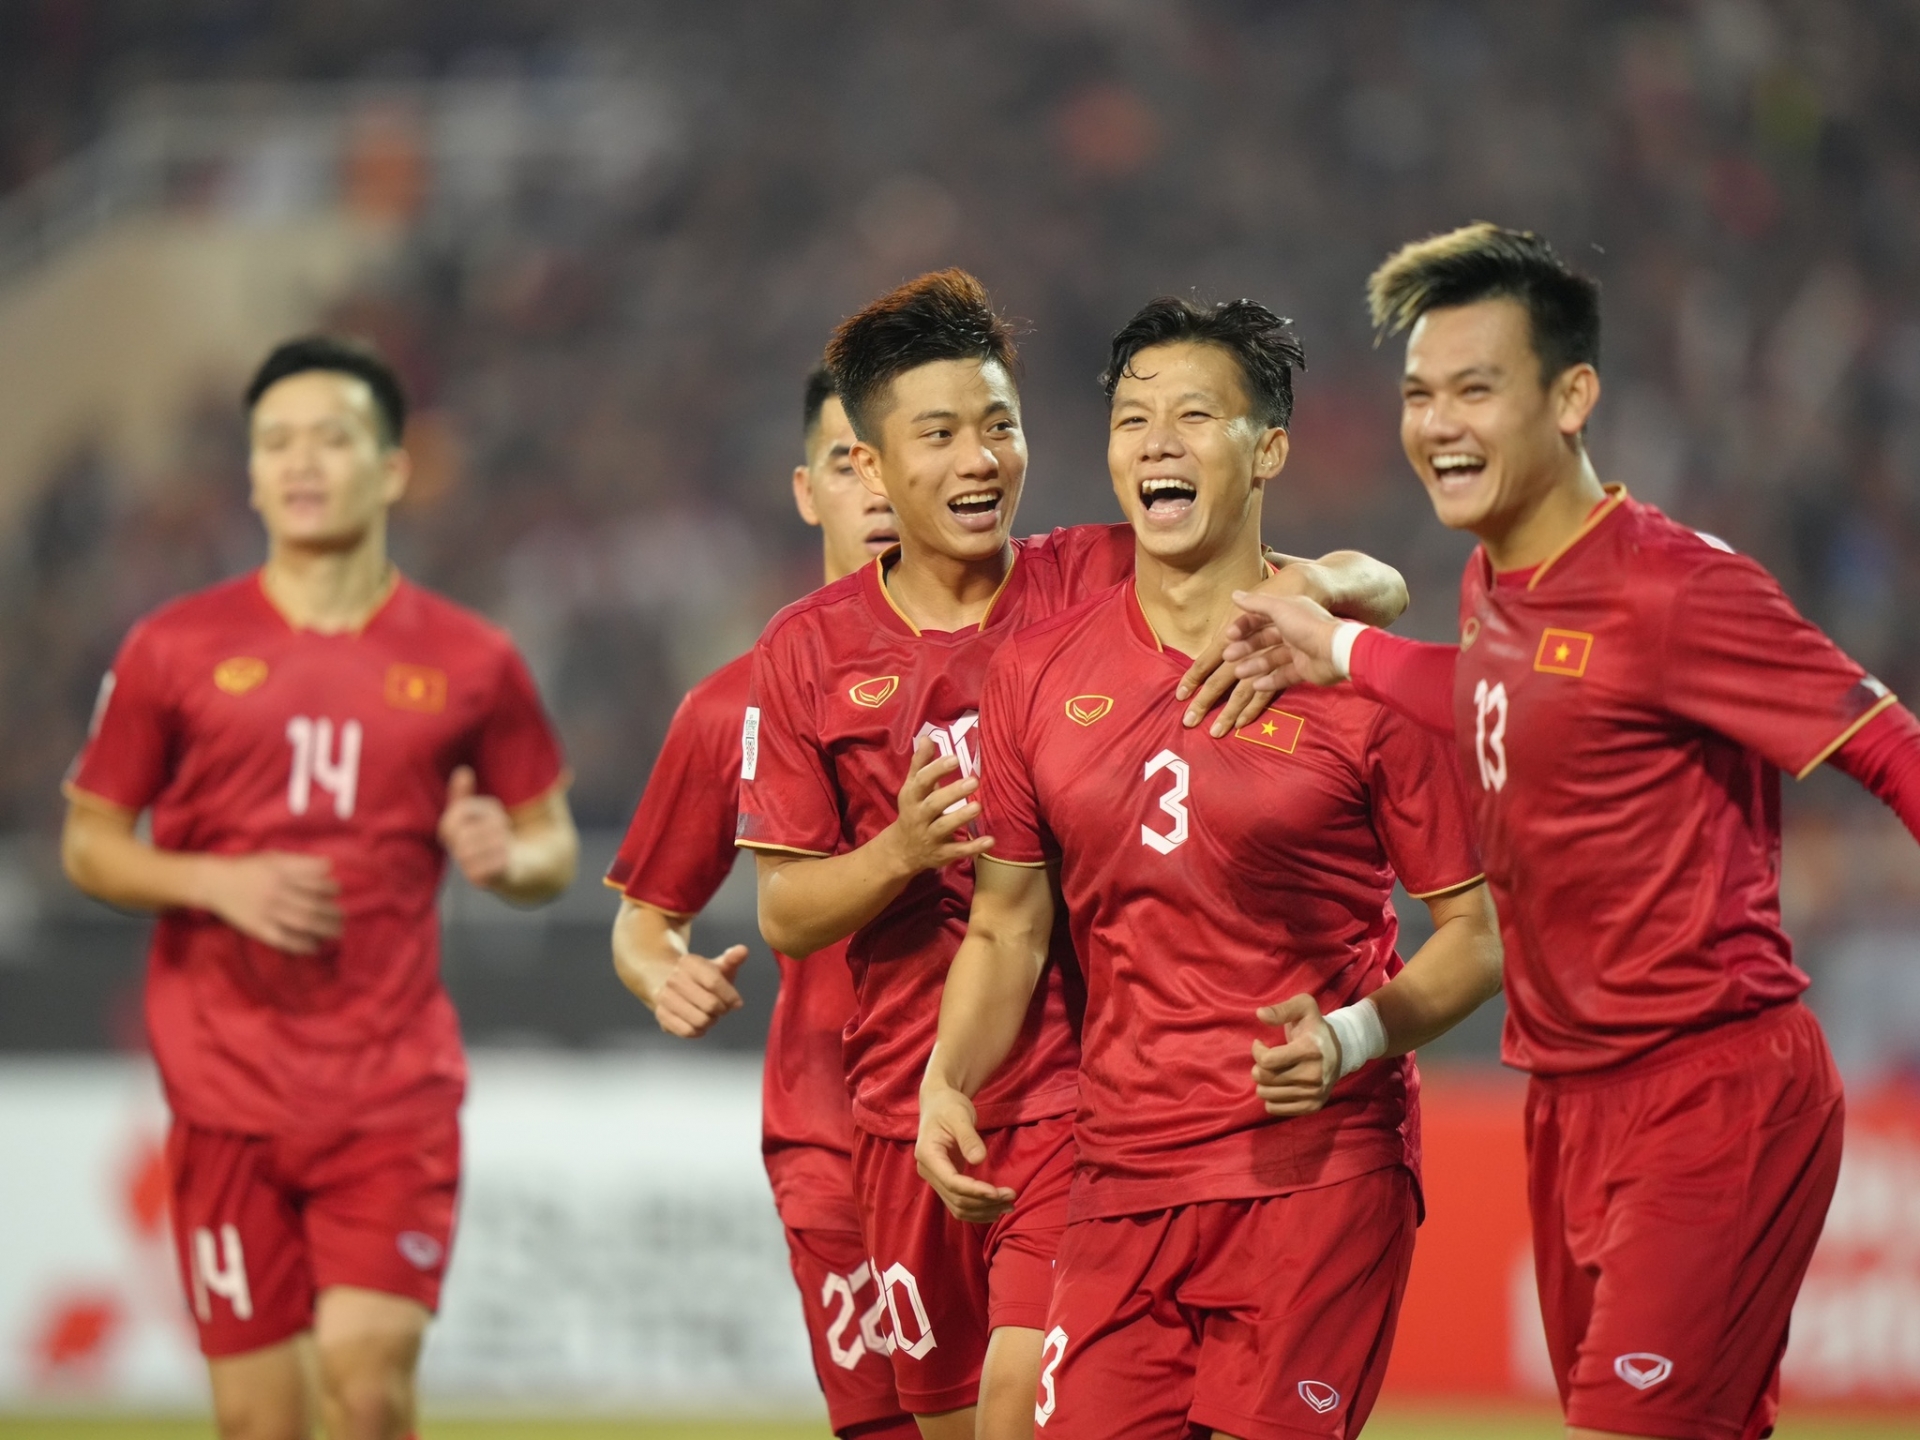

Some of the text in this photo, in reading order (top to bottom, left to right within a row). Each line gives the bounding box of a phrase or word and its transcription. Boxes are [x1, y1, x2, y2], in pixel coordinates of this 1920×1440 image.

[284, 714, 363, 820] 14
[1474, 678, 1508, 794] 13
[1141, 748, 1190, 856] 3
[190, 1222, 254, 1322] 14
[1035, 1325, 1070, 1428] 3
